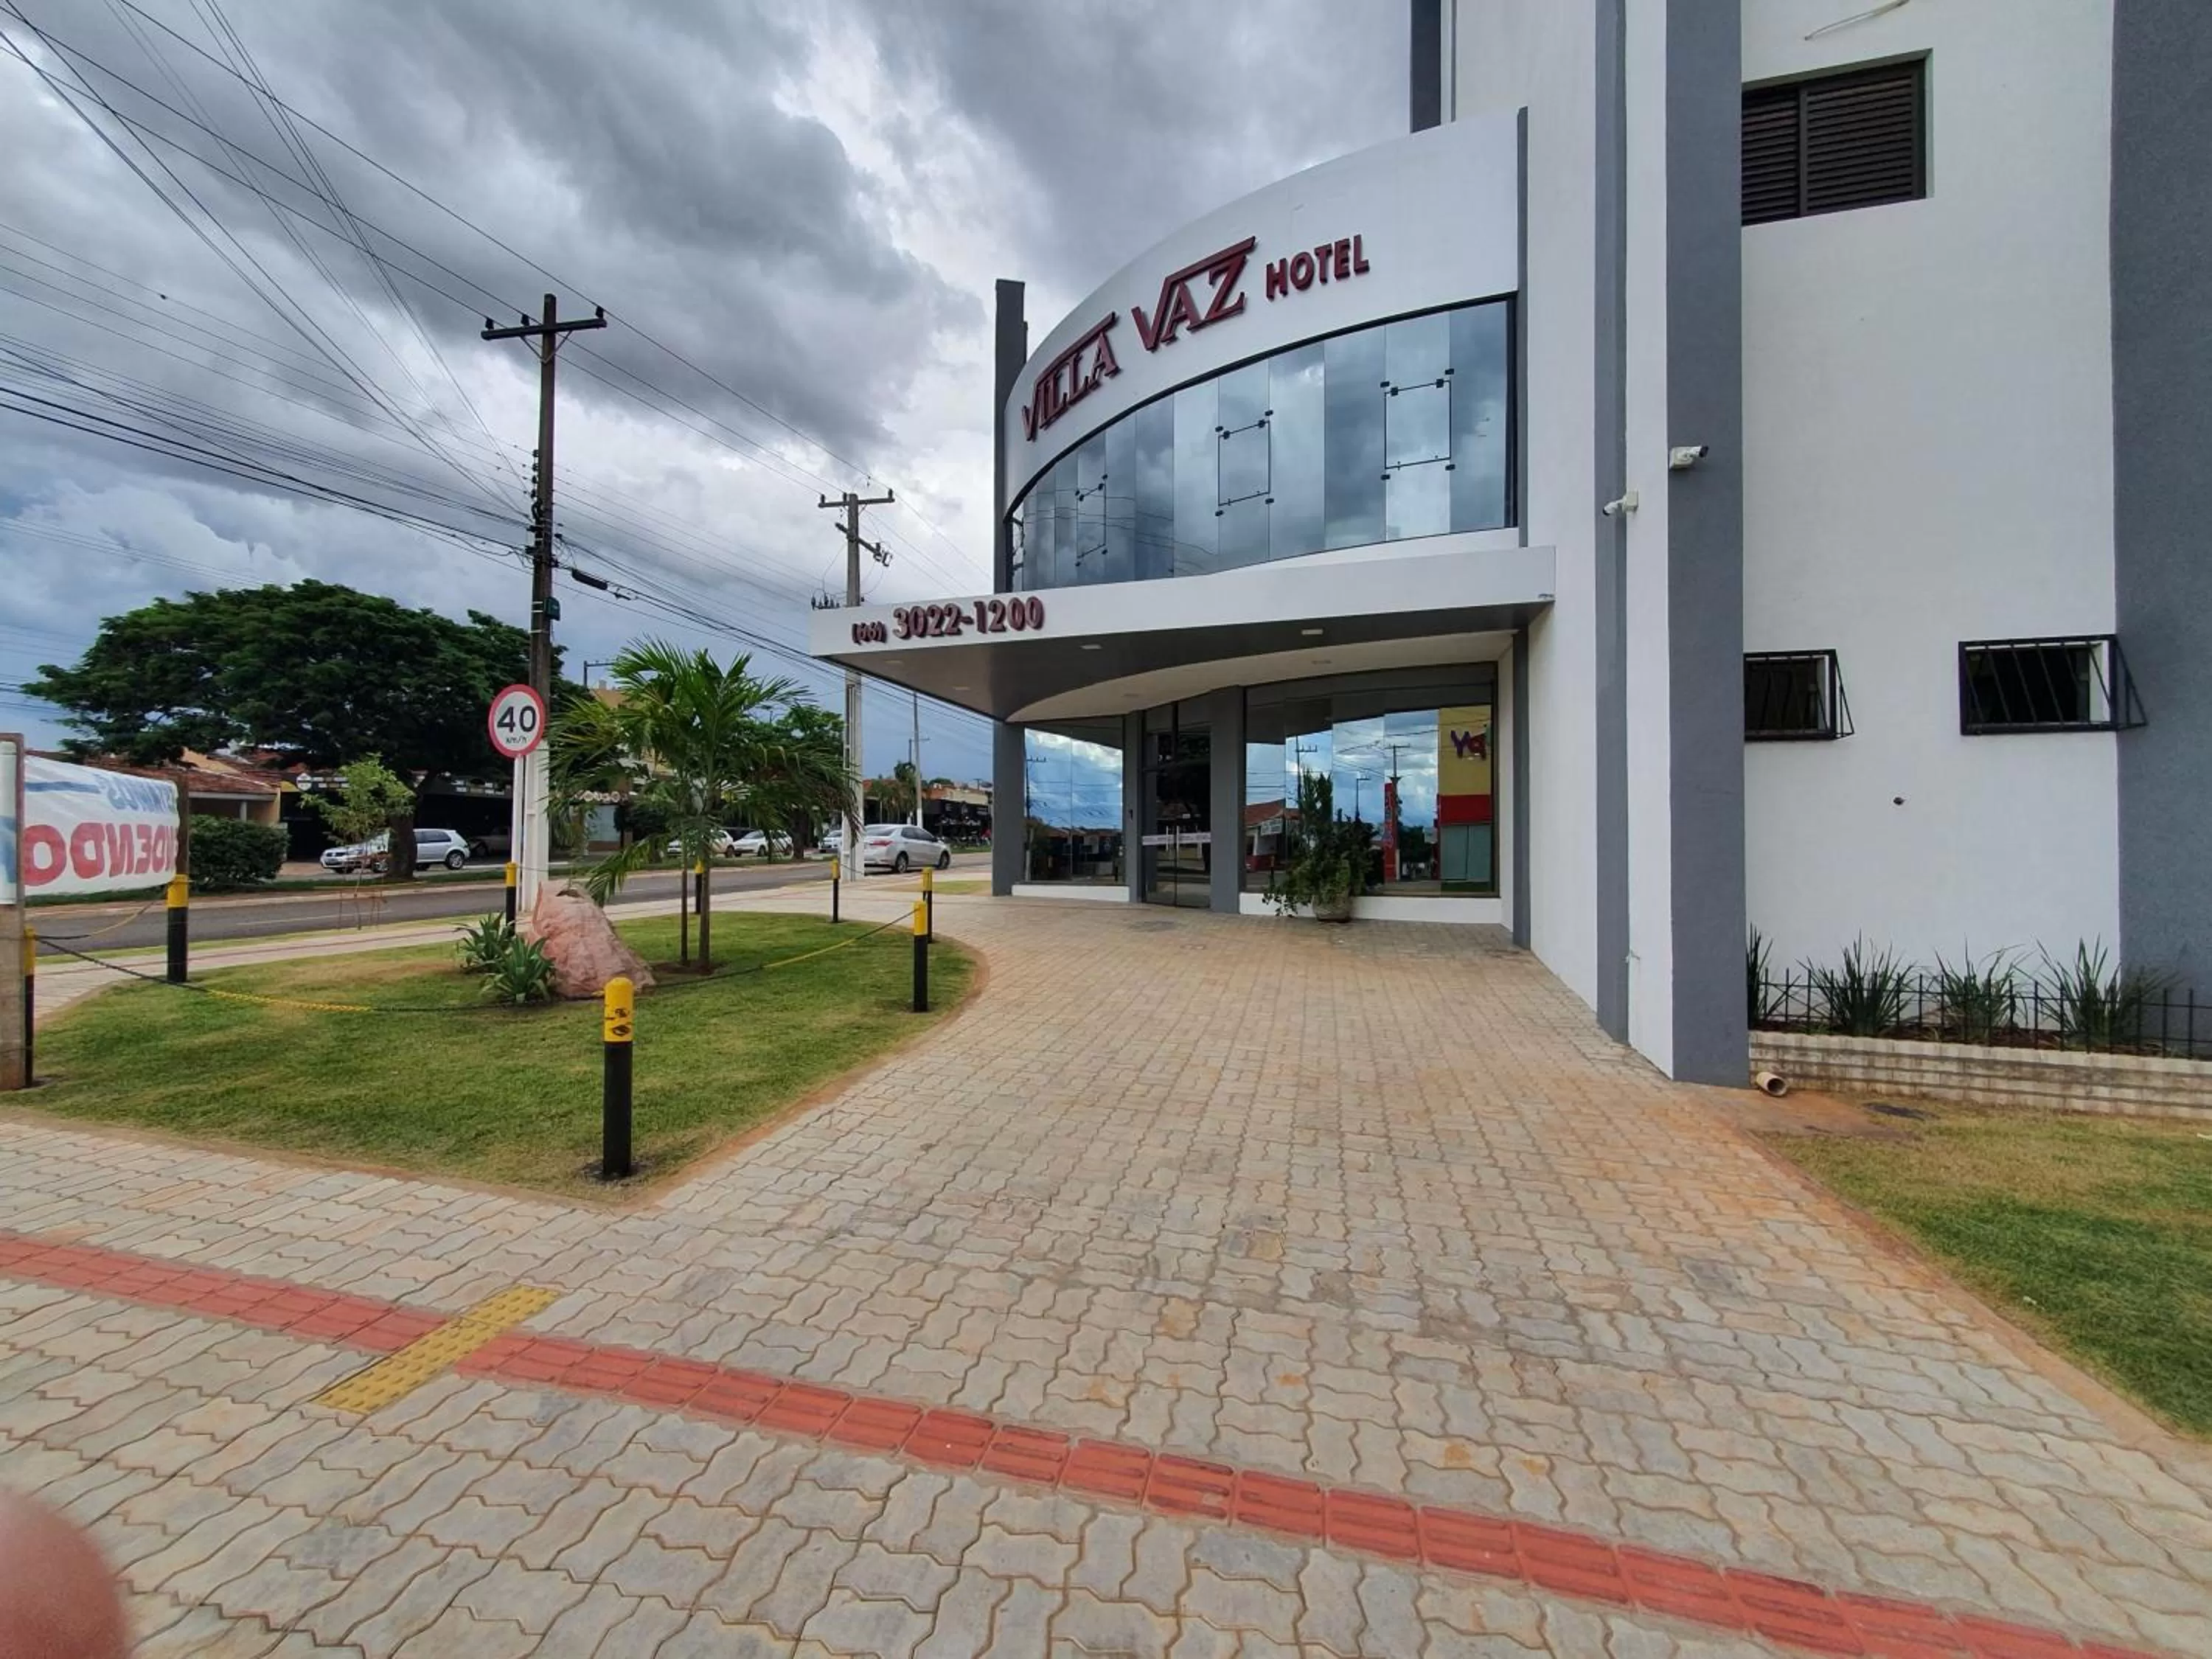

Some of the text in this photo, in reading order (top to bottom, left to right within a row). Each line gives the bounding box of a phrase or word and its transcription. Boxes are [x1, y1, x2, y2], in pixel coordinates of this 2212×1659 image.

[1022, 234, 1370, 442] VILLA VAZ HOTEL
[893, 596, 1044, 639] 3022-1200
[496, 706, 537, 733] 40
